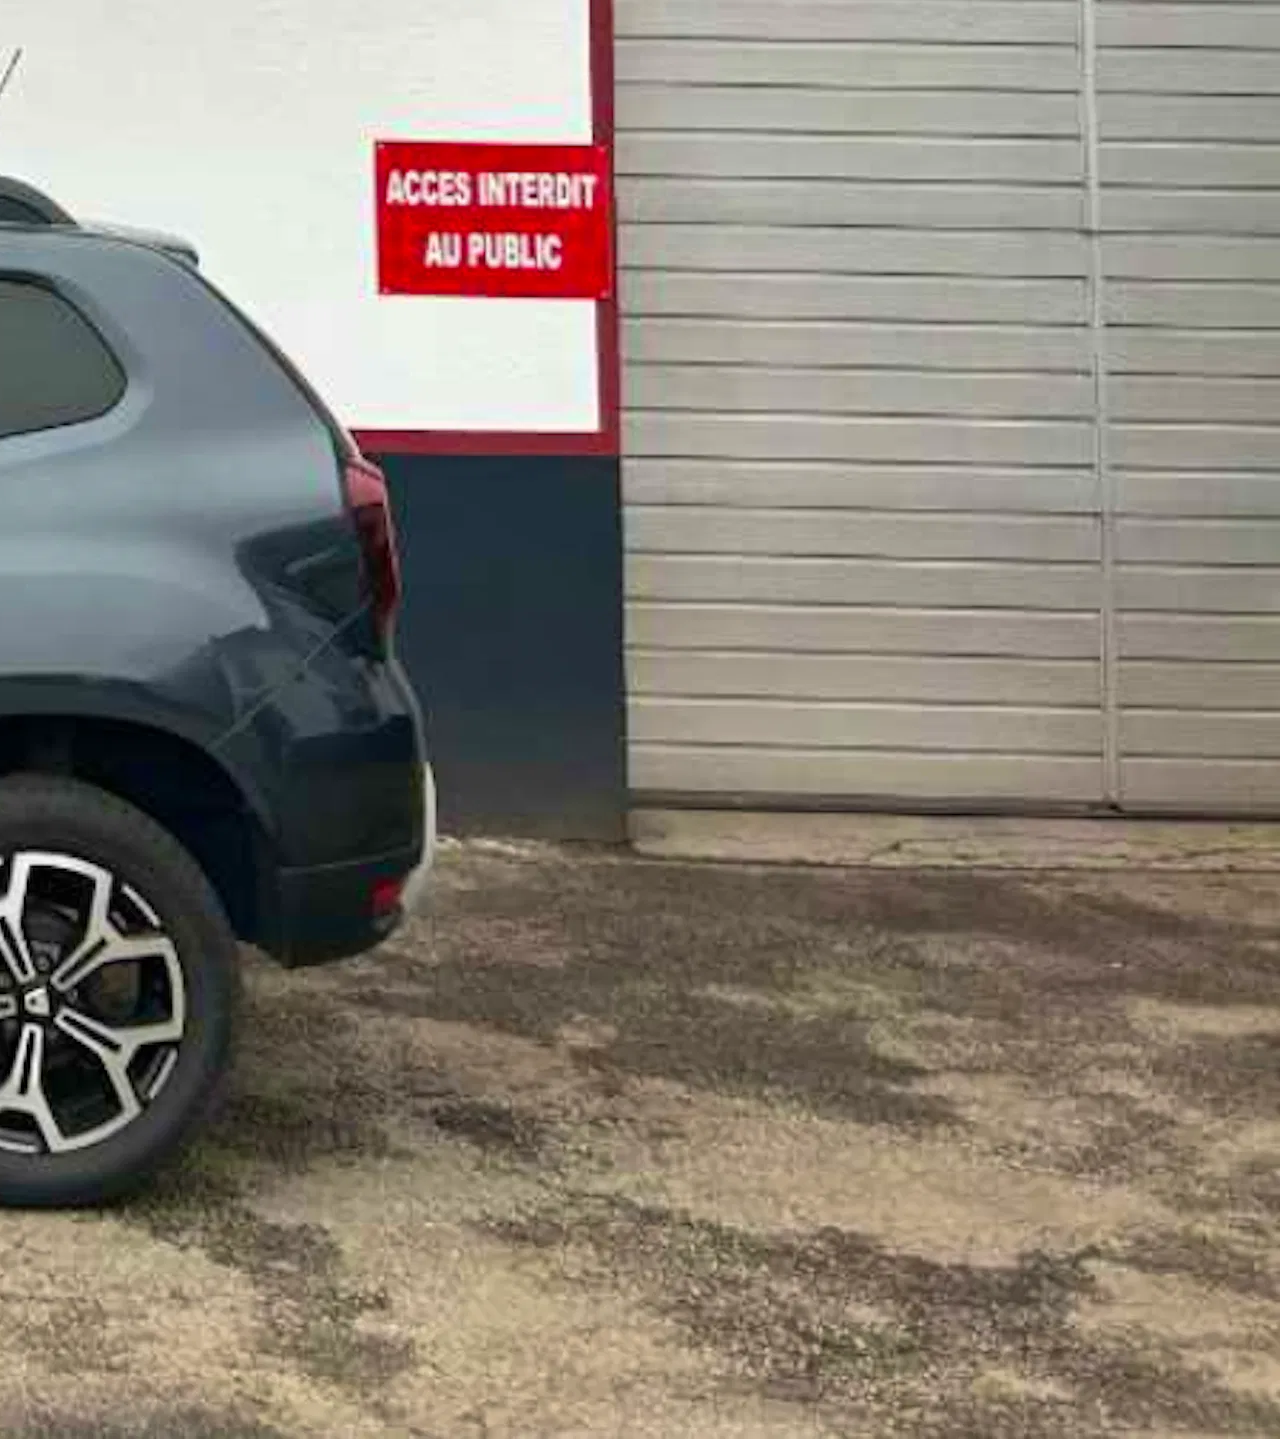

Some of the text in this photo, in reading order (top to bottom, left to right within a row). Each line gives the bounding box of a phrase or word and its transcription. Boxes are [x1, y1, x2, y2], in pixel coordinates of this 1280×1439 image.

[386, 168, 597, 208] ACCES INTERDIT
[424, 231, 563, 270] AU PUBLIC
